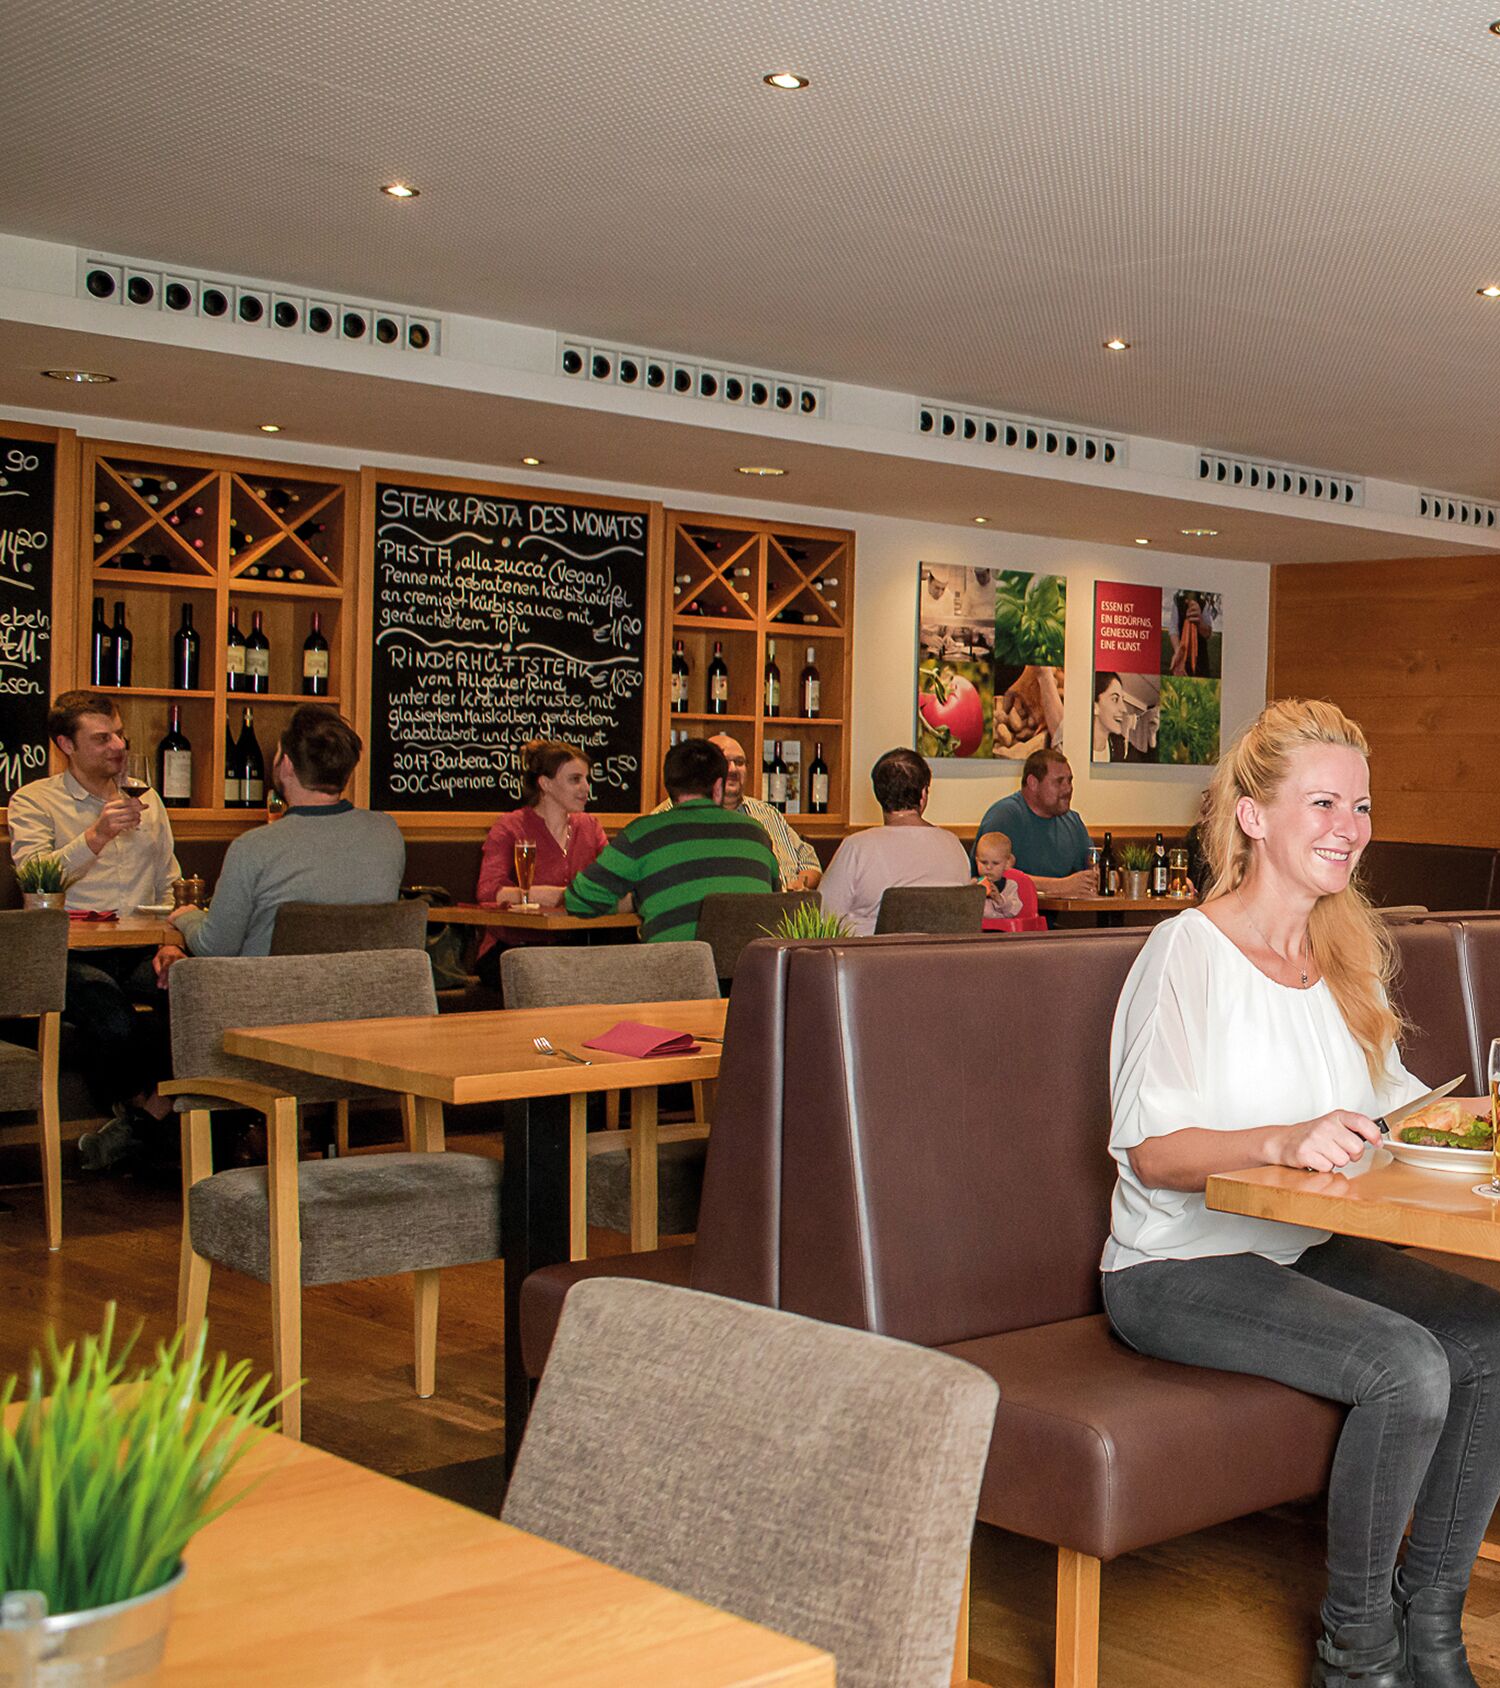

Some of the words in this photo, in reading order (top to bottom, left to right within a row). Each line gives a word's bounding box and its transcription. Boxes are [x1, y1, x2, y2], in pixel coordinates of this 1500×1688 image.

[529, 504, 568, 533] DES
[573, 509, 643, 540] MONATS
[378, 540, 451, 568] PASTA
[549, 560, 611, 594] (Vegan)
[381, 563, 428, 585] Penne
[430, 569, 454, 587] mit
[451, 572, 540, 601] gebratenen
[381, 589, 401, 603] an
[403, 592, 468, 618] cremiger
[567, 606, 594, 625] mit
[1100, 600, 1123, 613] ESSEN
[1124, 603, 1134, 613] IST
[380, 605, 490, 631] geräuchertem
[490, 613, 530, 643] Tofu
[1100, 614, 1112, 624] EIN
[1113, 614, 1153, 628] BEDÜRFNIS,
[1100, 626, 1138, 639] GENIESSEN
[1139, 630, 1150, 640] IST
[1100, 639, 1116, 650] EINE
[417, 674, 452, 689] vom
[457, 671, 526, 698] Allgäuer
[525, 673, 566, 691] Rind
[388, 686, 430, 706] unter
[432, 688, 456, 706] der
[588, 691, 616, 710] mit
[388, 706, 463, 730] glasiertem
[390, 722, 480, 742] Ciabattabrot
[482, 727, 509, 743] und
[393, 752, 429, 772] 2017
[430, 750, 491, 770] Barbera
[390, 774, 429, 793] DOC
[430, 772, 497, 798] Superiore
